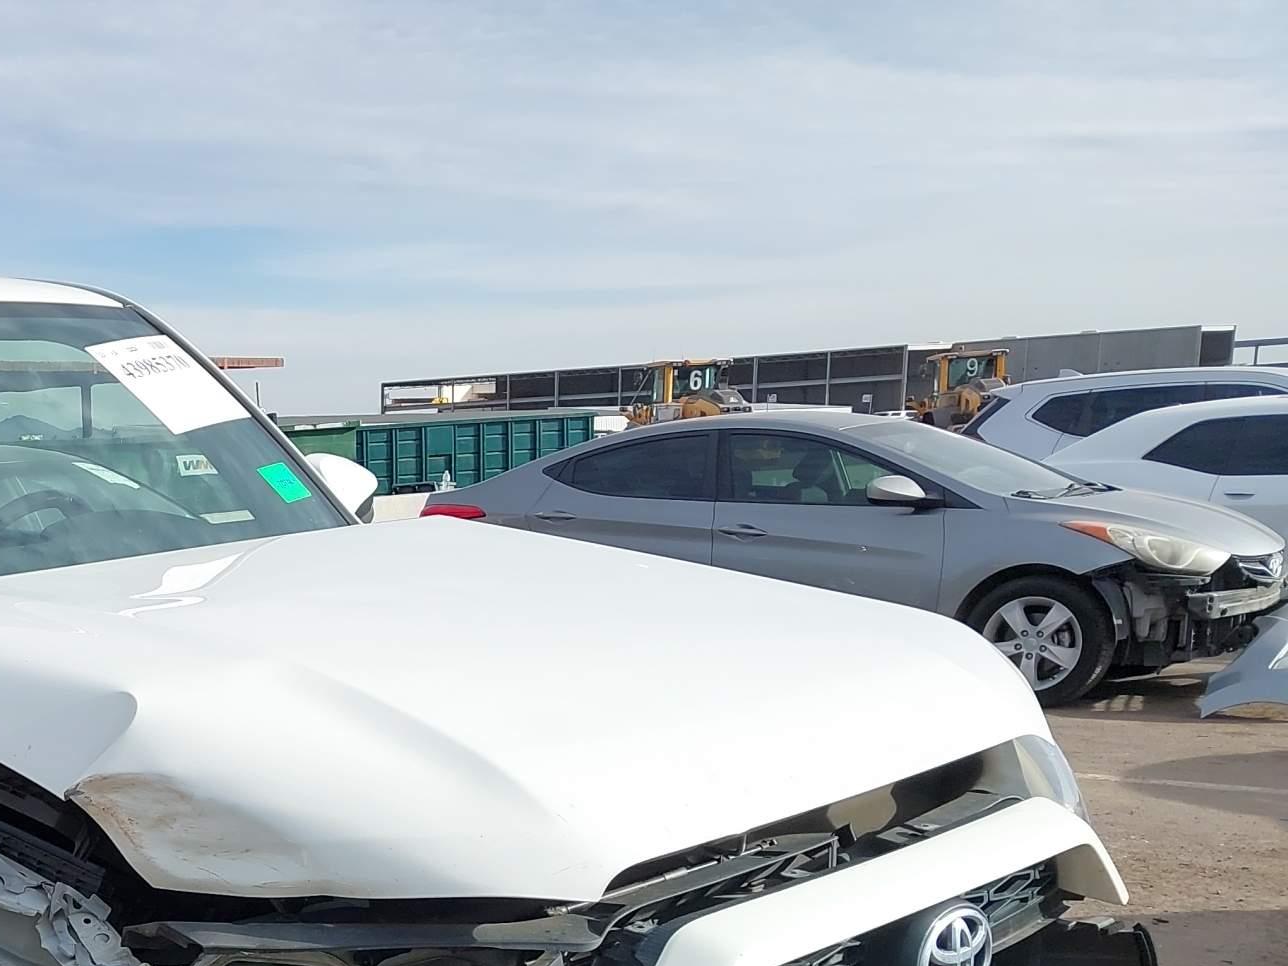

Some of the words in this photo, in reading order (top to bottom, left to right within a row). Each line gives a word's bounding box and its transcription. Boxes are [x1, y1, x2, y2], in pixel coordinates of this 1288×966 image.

[121, 354, 190, 379] 43985370
[966, 358, 978, 377] 9
[689, 367, 710, 390] 61
